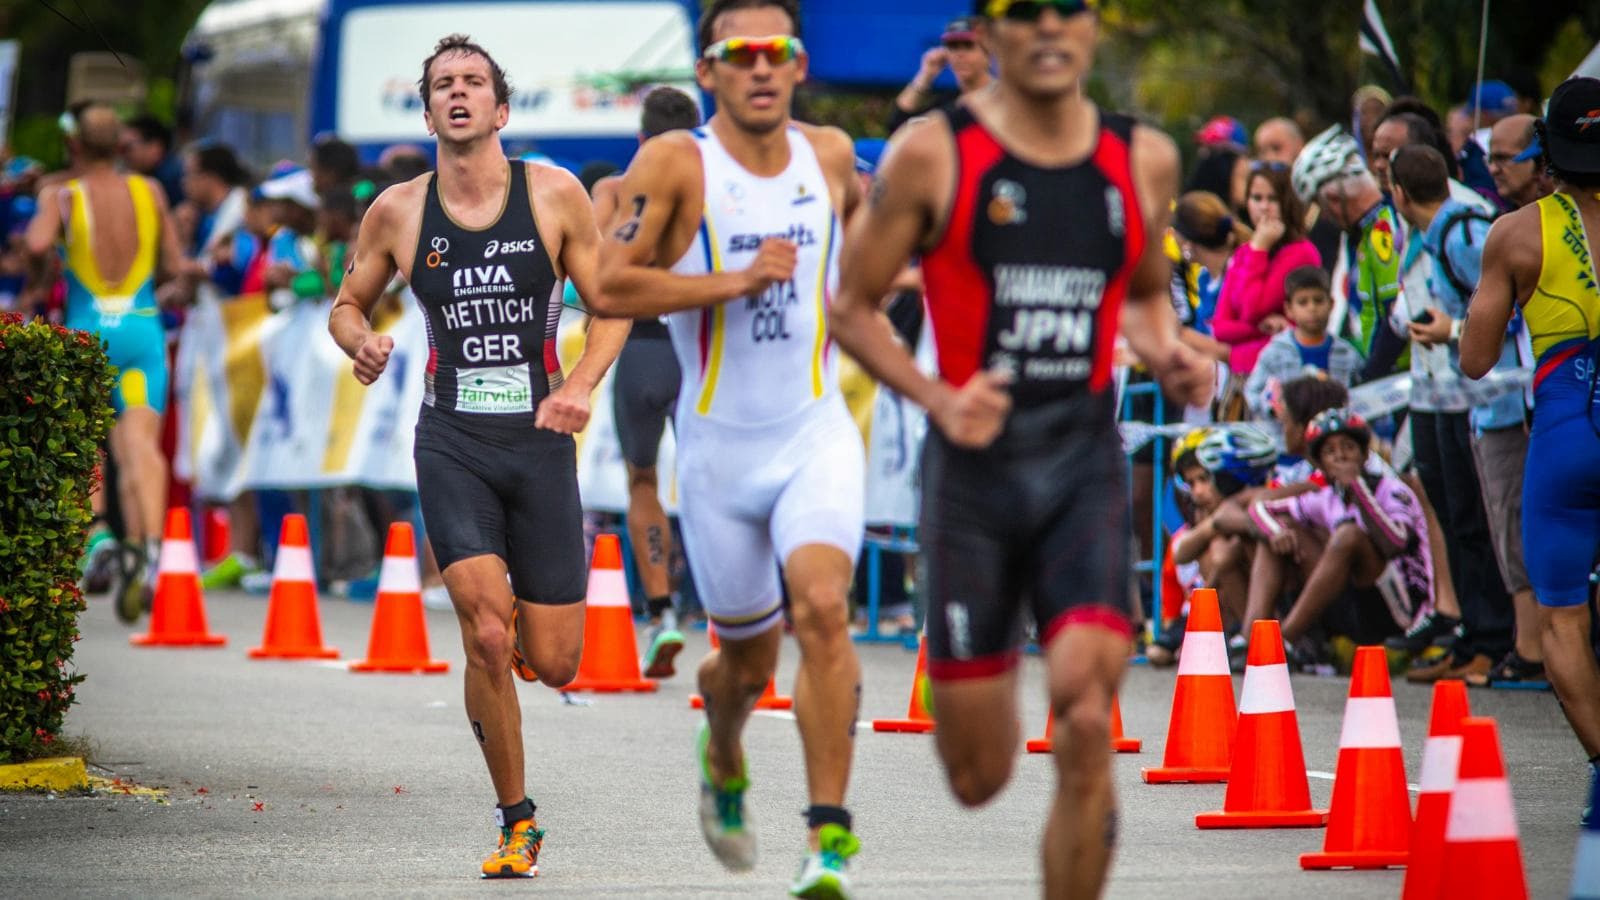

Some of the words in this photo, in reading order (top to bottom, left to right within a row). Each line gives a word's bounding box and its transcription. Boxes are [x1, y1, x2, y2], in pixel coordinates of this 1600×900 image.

[501, 240, 535, 254] asics
[454, 284, 515, 297] ENGINEERING
[441, 297, 534, 330] HETTICH
[752, 310, 791, 343] COL
[997, 309, 1092, 353] JPN
[462, 334, 523, 362] GER
